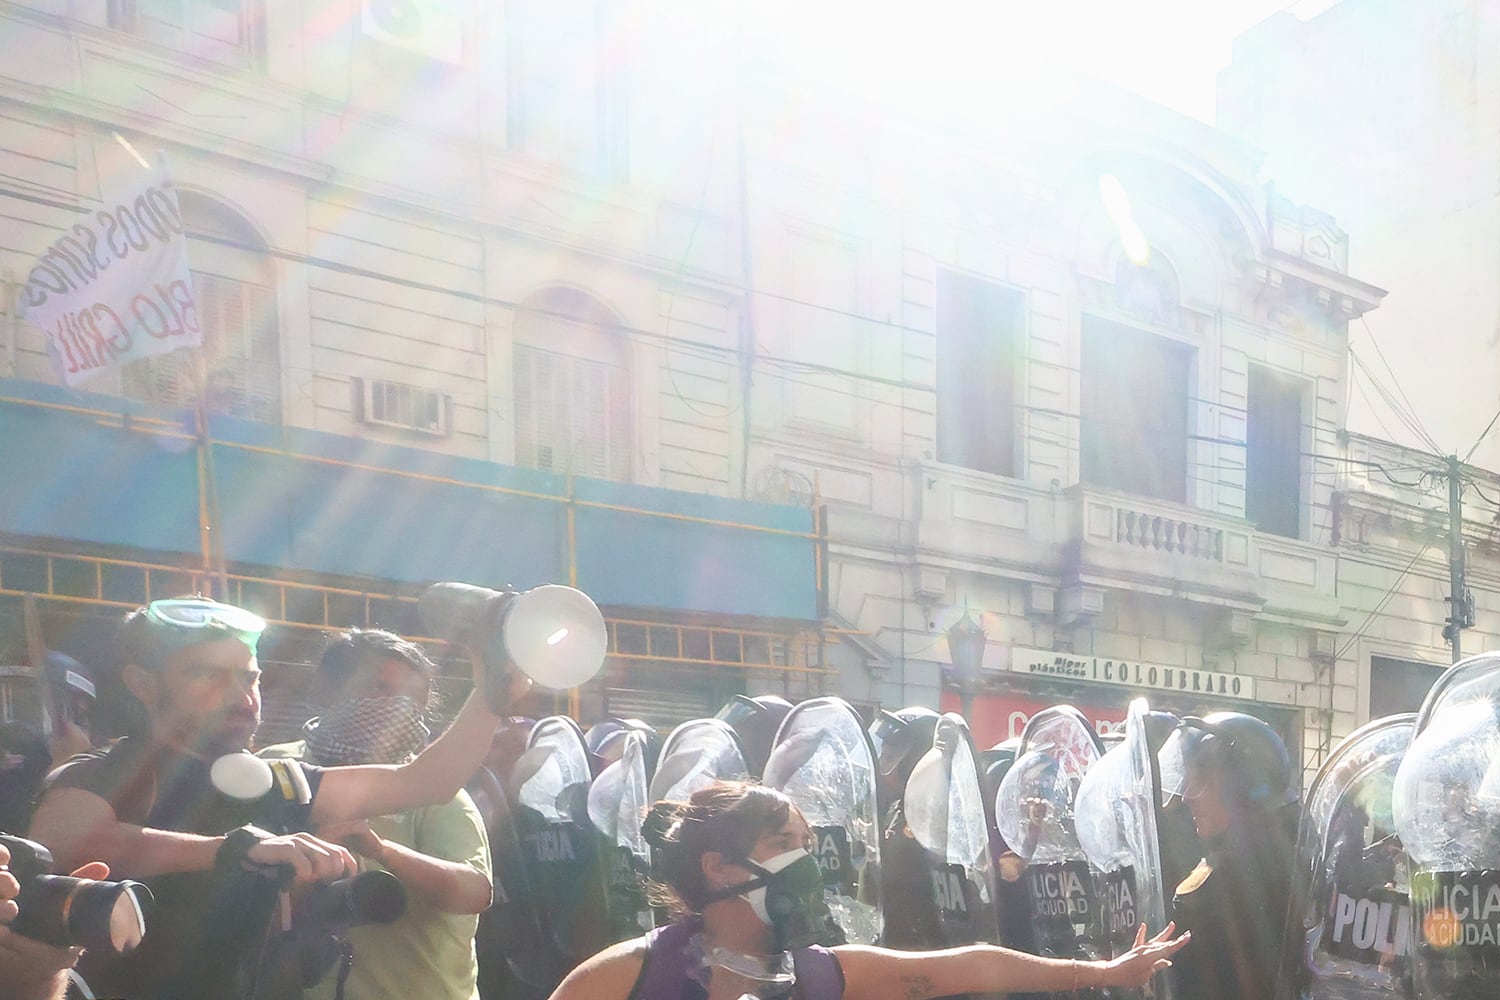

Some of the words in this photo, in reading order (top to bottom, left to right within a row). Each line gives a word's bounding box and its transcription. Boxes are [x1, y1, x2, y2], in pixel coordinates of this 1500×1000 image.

[1104, 660, 1241, 695] COLOMBRARO
[1031, 871, 1087, 899] LICIA
[1332, 893, 1411, 957] POLI
